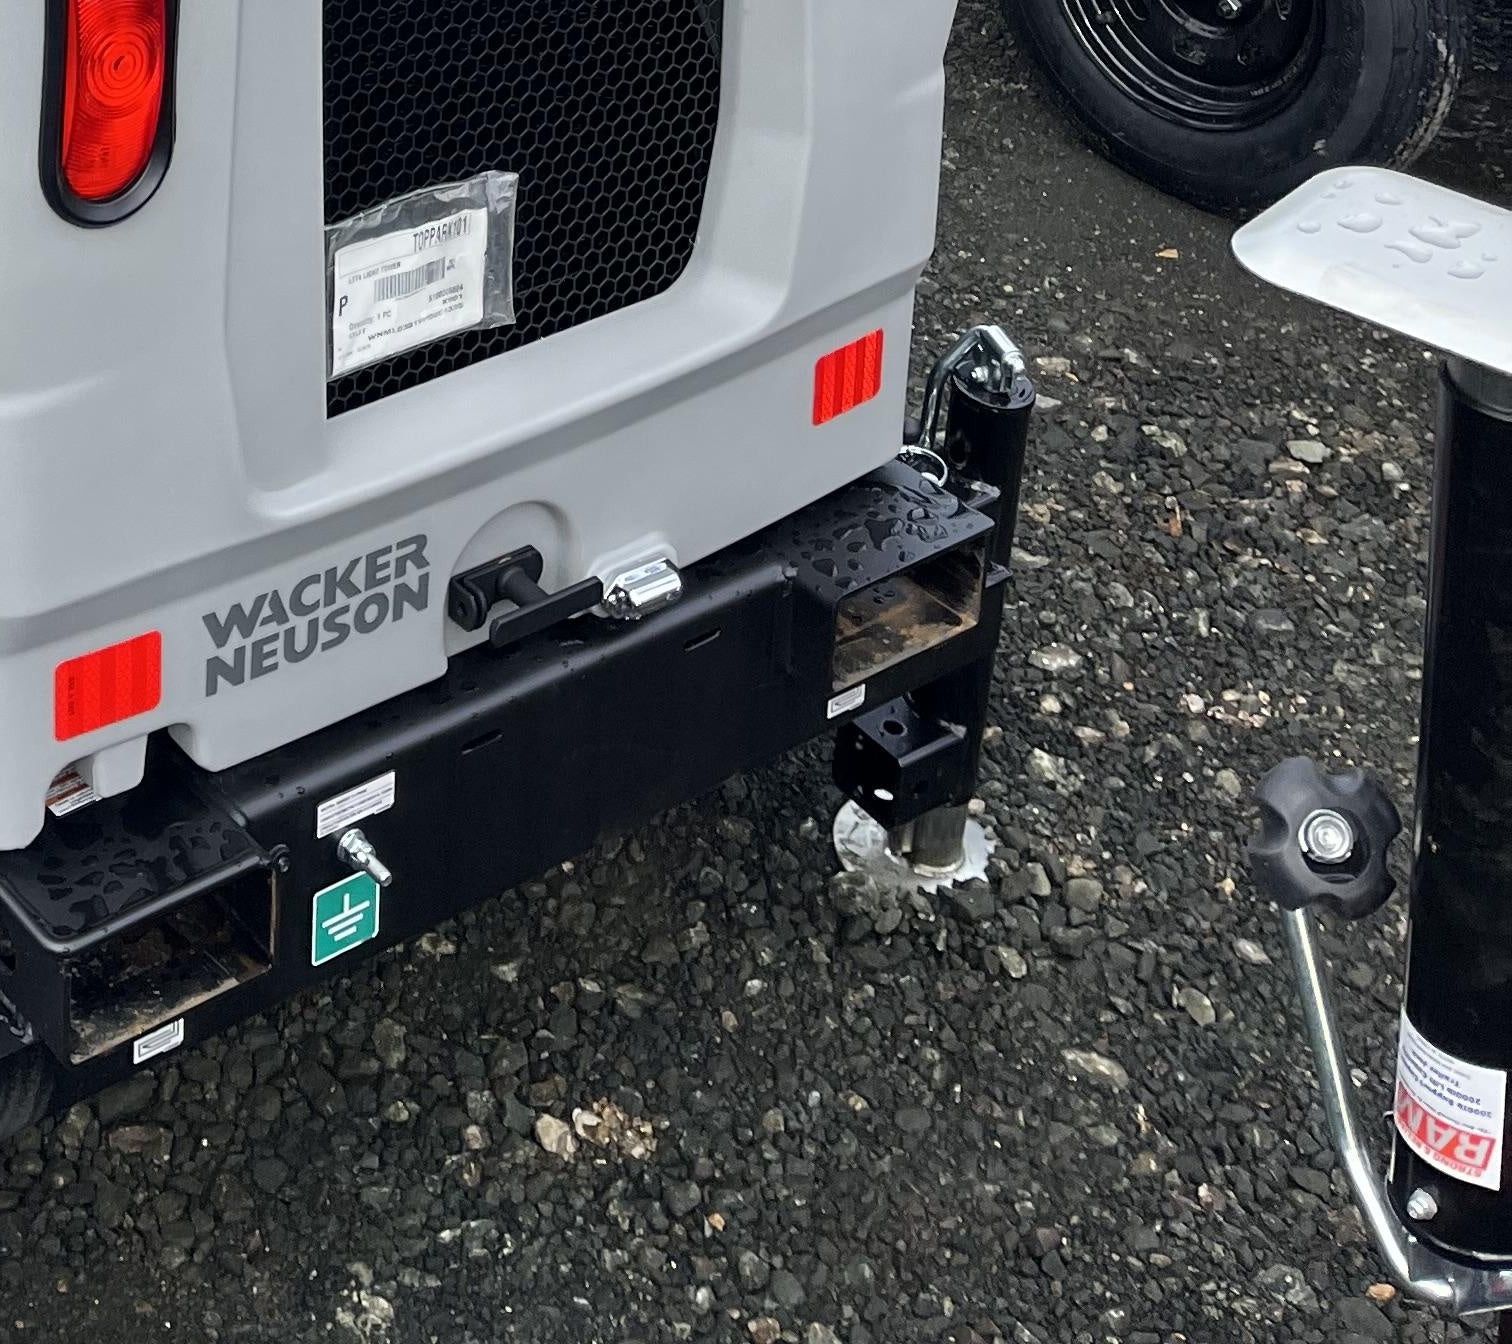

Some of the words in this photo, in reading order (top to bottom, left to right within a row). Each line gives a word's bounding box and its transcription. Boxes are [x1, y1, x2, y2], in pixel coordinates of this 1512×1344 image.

[338, 295, 348, 316] P
[202, 534, 430, 649] WACKER
[206, 572, 429, 697] NEUSON
[1396, 1089, 1491, 1166] RAM
[1433, 1151, 1482, 1178] STRONG
